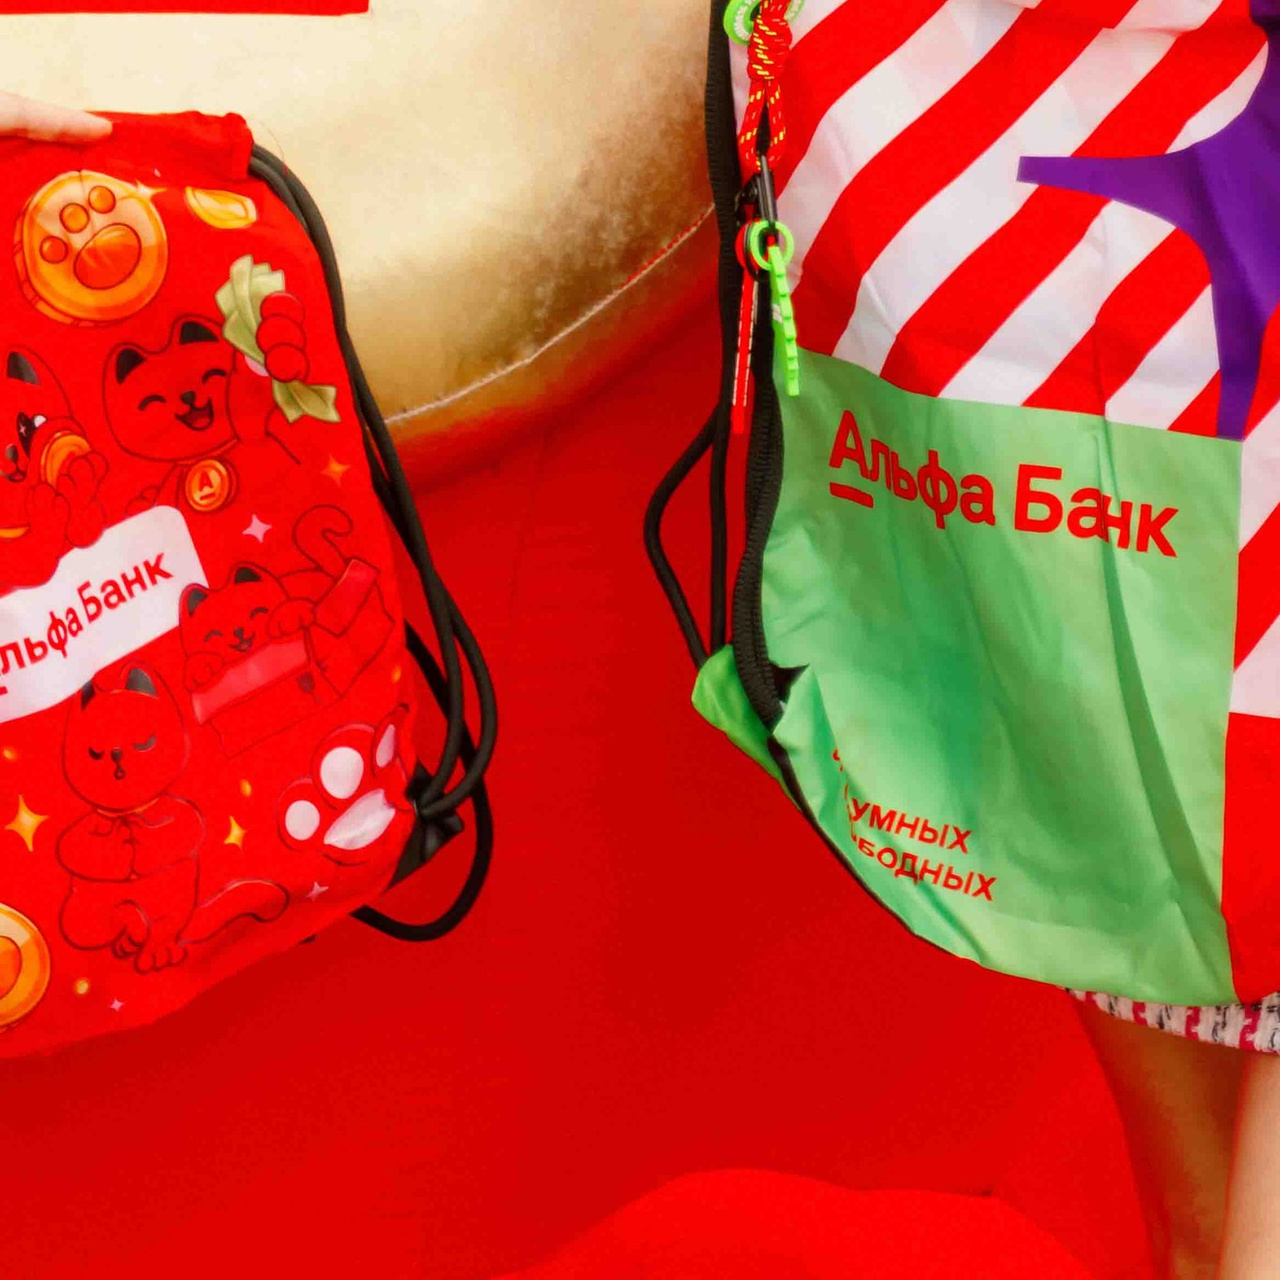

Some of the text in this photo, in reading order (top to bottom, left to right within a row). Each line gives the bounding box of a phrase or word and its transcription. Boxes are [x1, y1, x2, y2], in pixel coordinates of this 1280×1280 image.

[829, 410, 1180, 558] Альфа Банк
[0, 553, 174, 675] льфа Банк
[851, 798, 973, 855] УМНЫХ
[852, 836, 997, 902] БОДНЫХ
